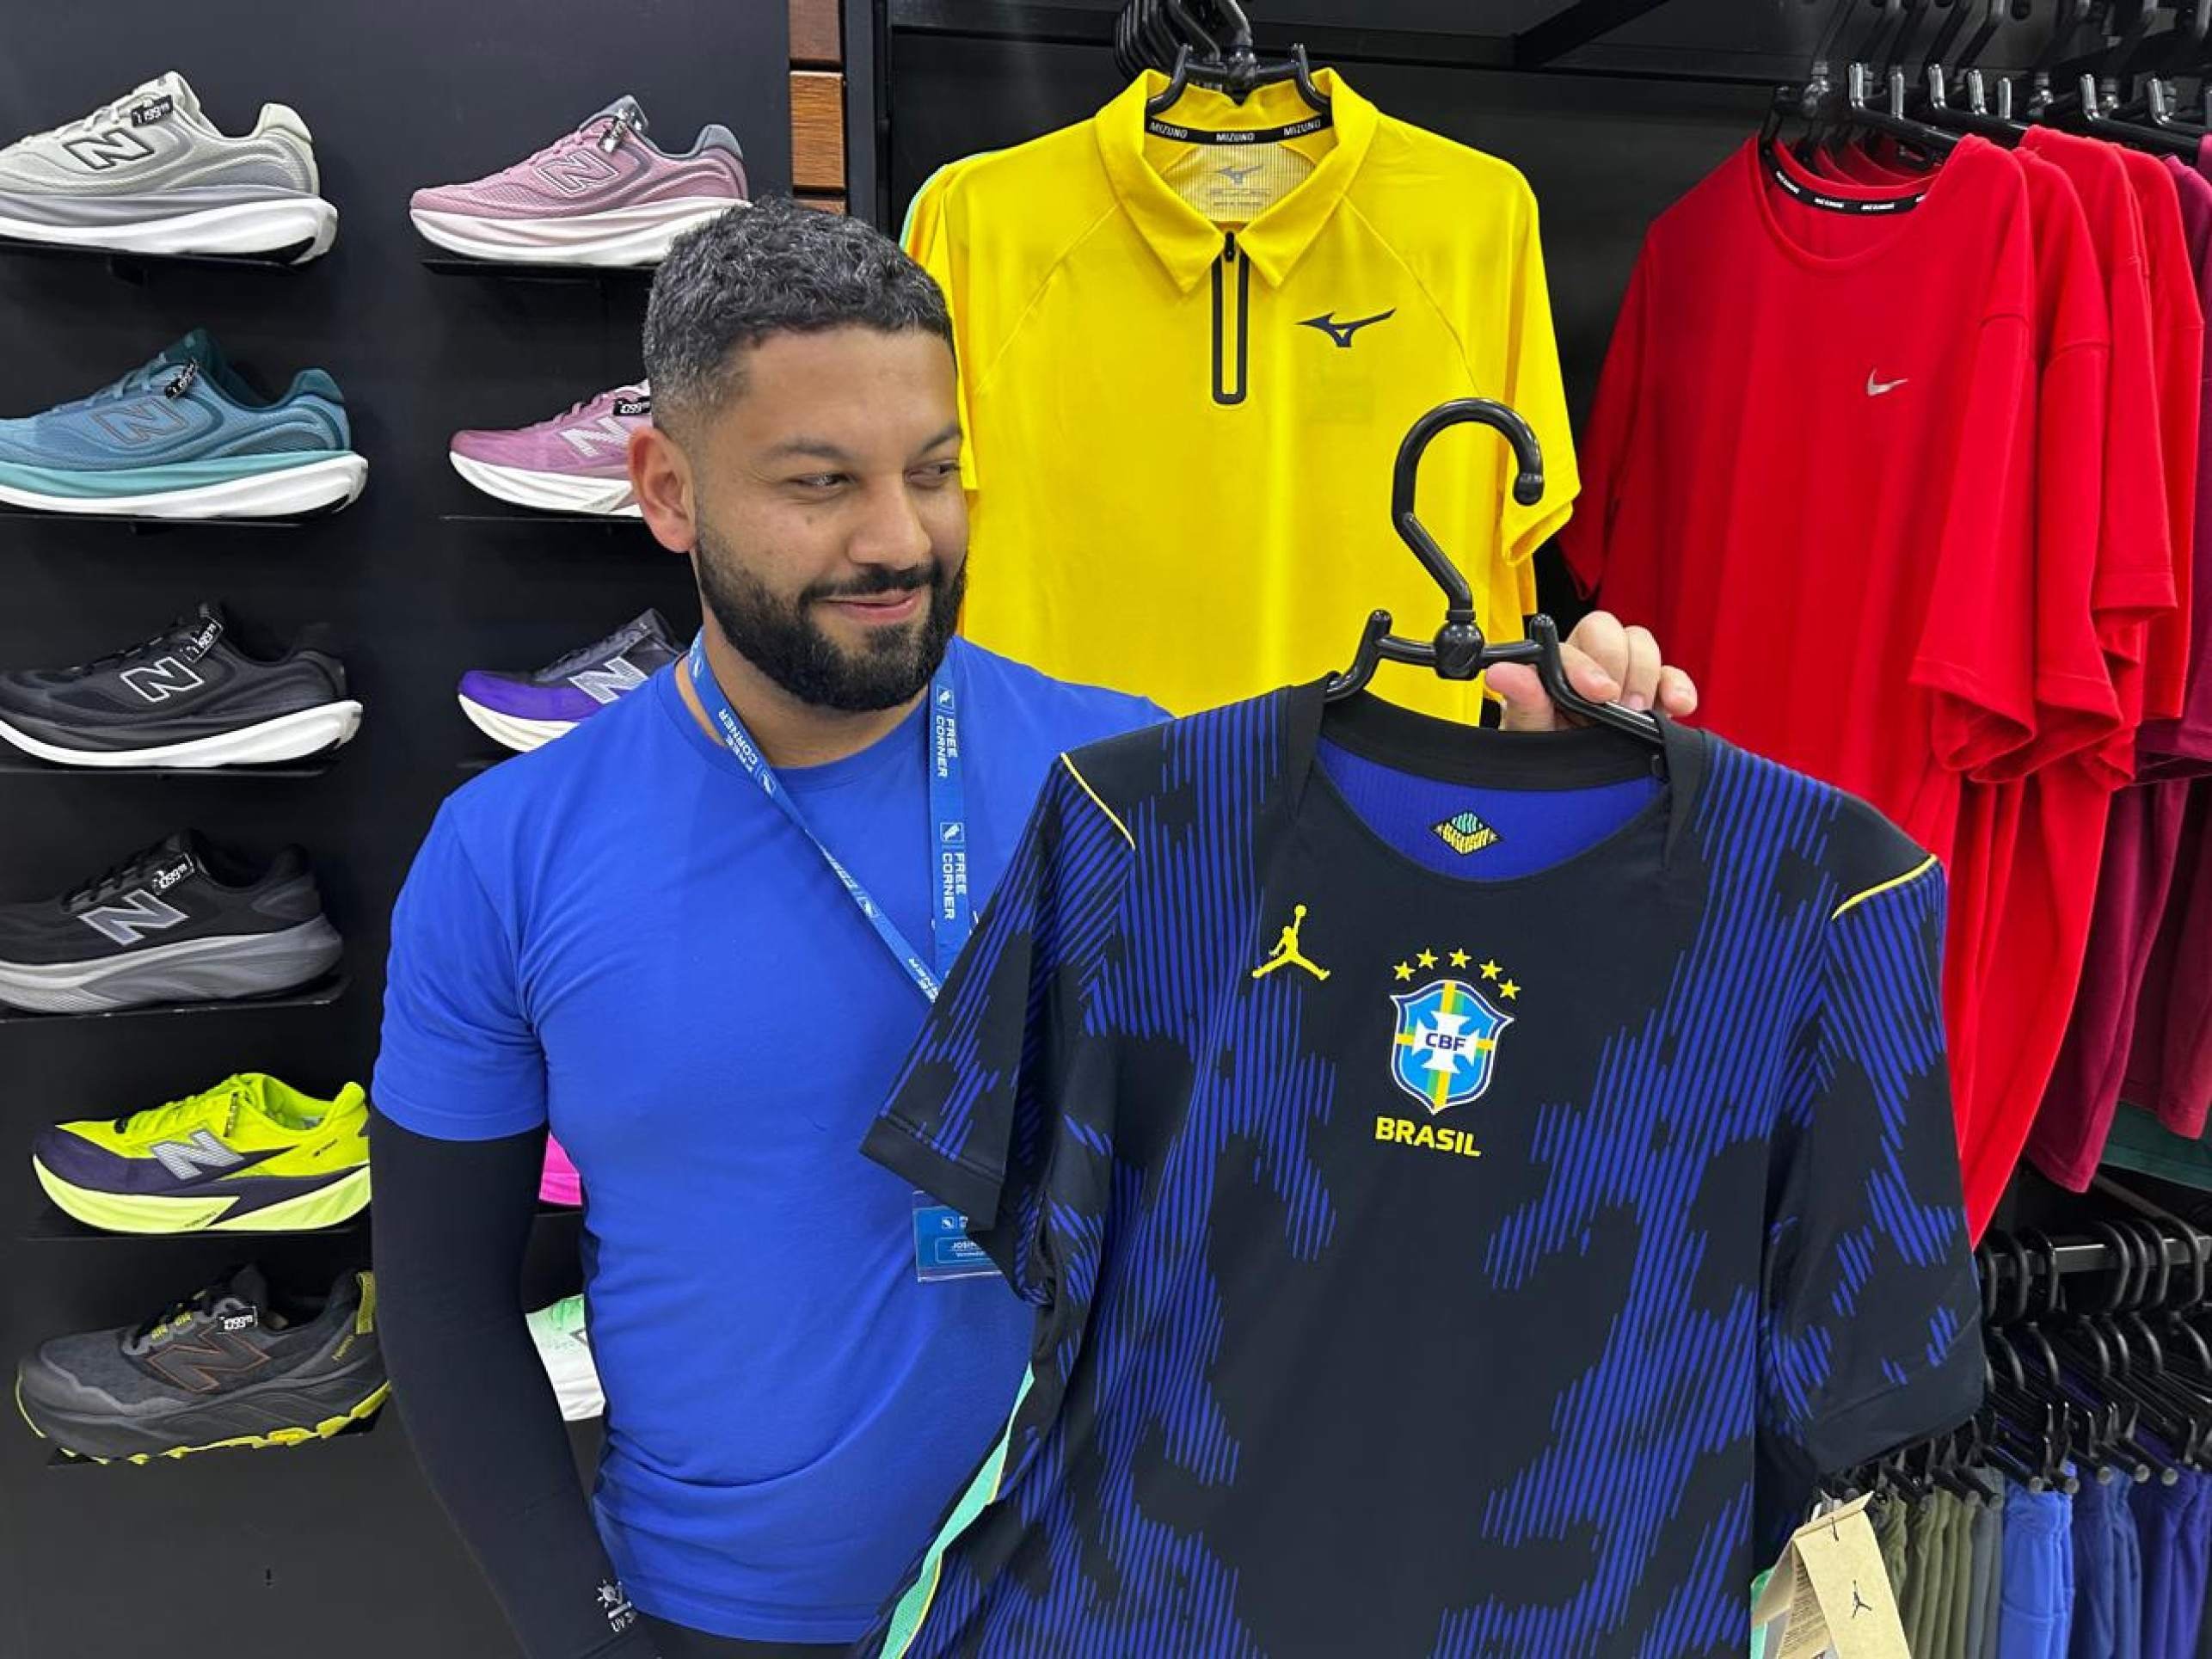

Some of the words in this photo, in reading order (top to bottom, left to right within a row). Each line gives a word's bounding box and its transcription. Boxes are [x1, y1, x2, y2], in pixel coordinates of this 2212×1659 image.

[61, 128, 157, 170] N
[1149, 120, 1189, 140] MIZUNO
[1215, 131, 1256, 143] MIZUNO
[1282, 118, 1321, 137] MIZUNO
[119, 656, 205, 702] N
[566, 654, 650, 705] N
[717, 707, 758, 765] CORNER
[936, 714, 948, 778] CORNER
[945, 716, 958, 758] FREE
[943, 851, 955, 920] CORNER
[954, 851, 968, 895] FREE
[76, 887, 191, 947] N
[1425, 1032, 1467, 1051] CBF
[150, 1129, 245, 1181] N
[1375, 1116, 1482, 1157] BRASIL
